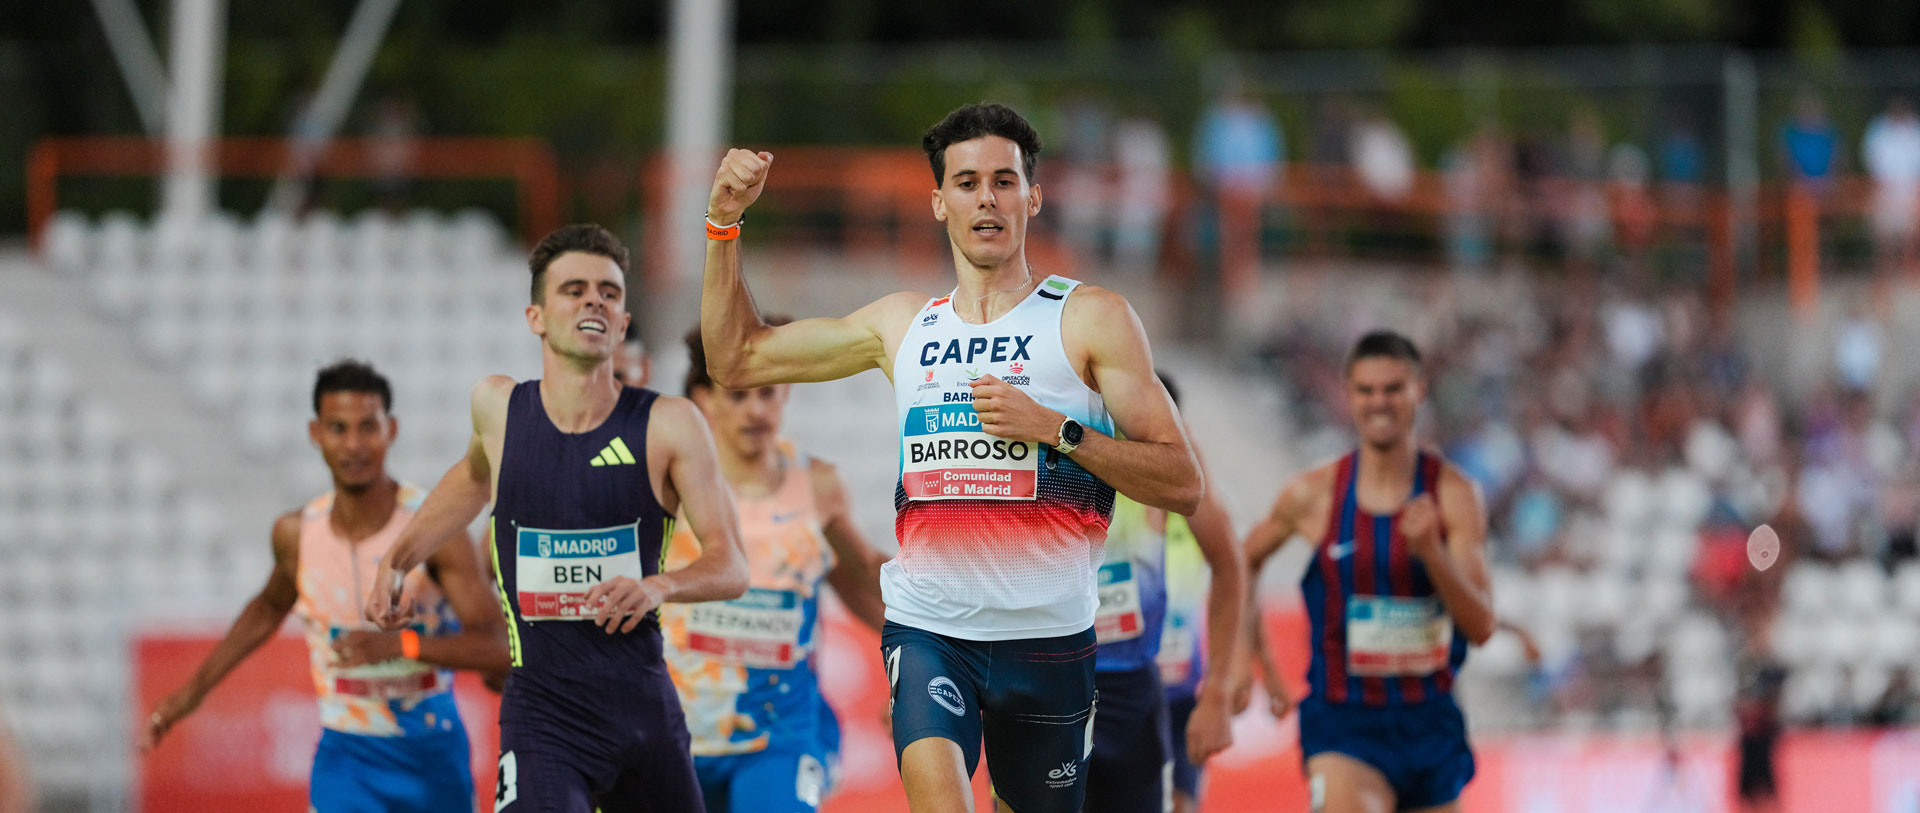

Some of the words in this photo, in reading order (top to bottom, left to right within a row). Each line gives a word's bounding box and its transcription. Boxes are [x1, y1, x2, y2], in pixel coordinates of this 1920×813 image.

[919, 335, 1034, 367] CAPEX
[943, 392, 976, 402] BARR
[942, 412, 980, 428] MAD
[910, 439, 1029, 463] BARROSO
[943, 471, 1012, 483] Comunidad
[943, 484, 960, 495] de
[964, 484, 1012, 496] Madrid
[553, 538, 618, 556] MADRID
[554, 565, 602, 584] BEN
[936, 687, 962, 705] CAPEX
